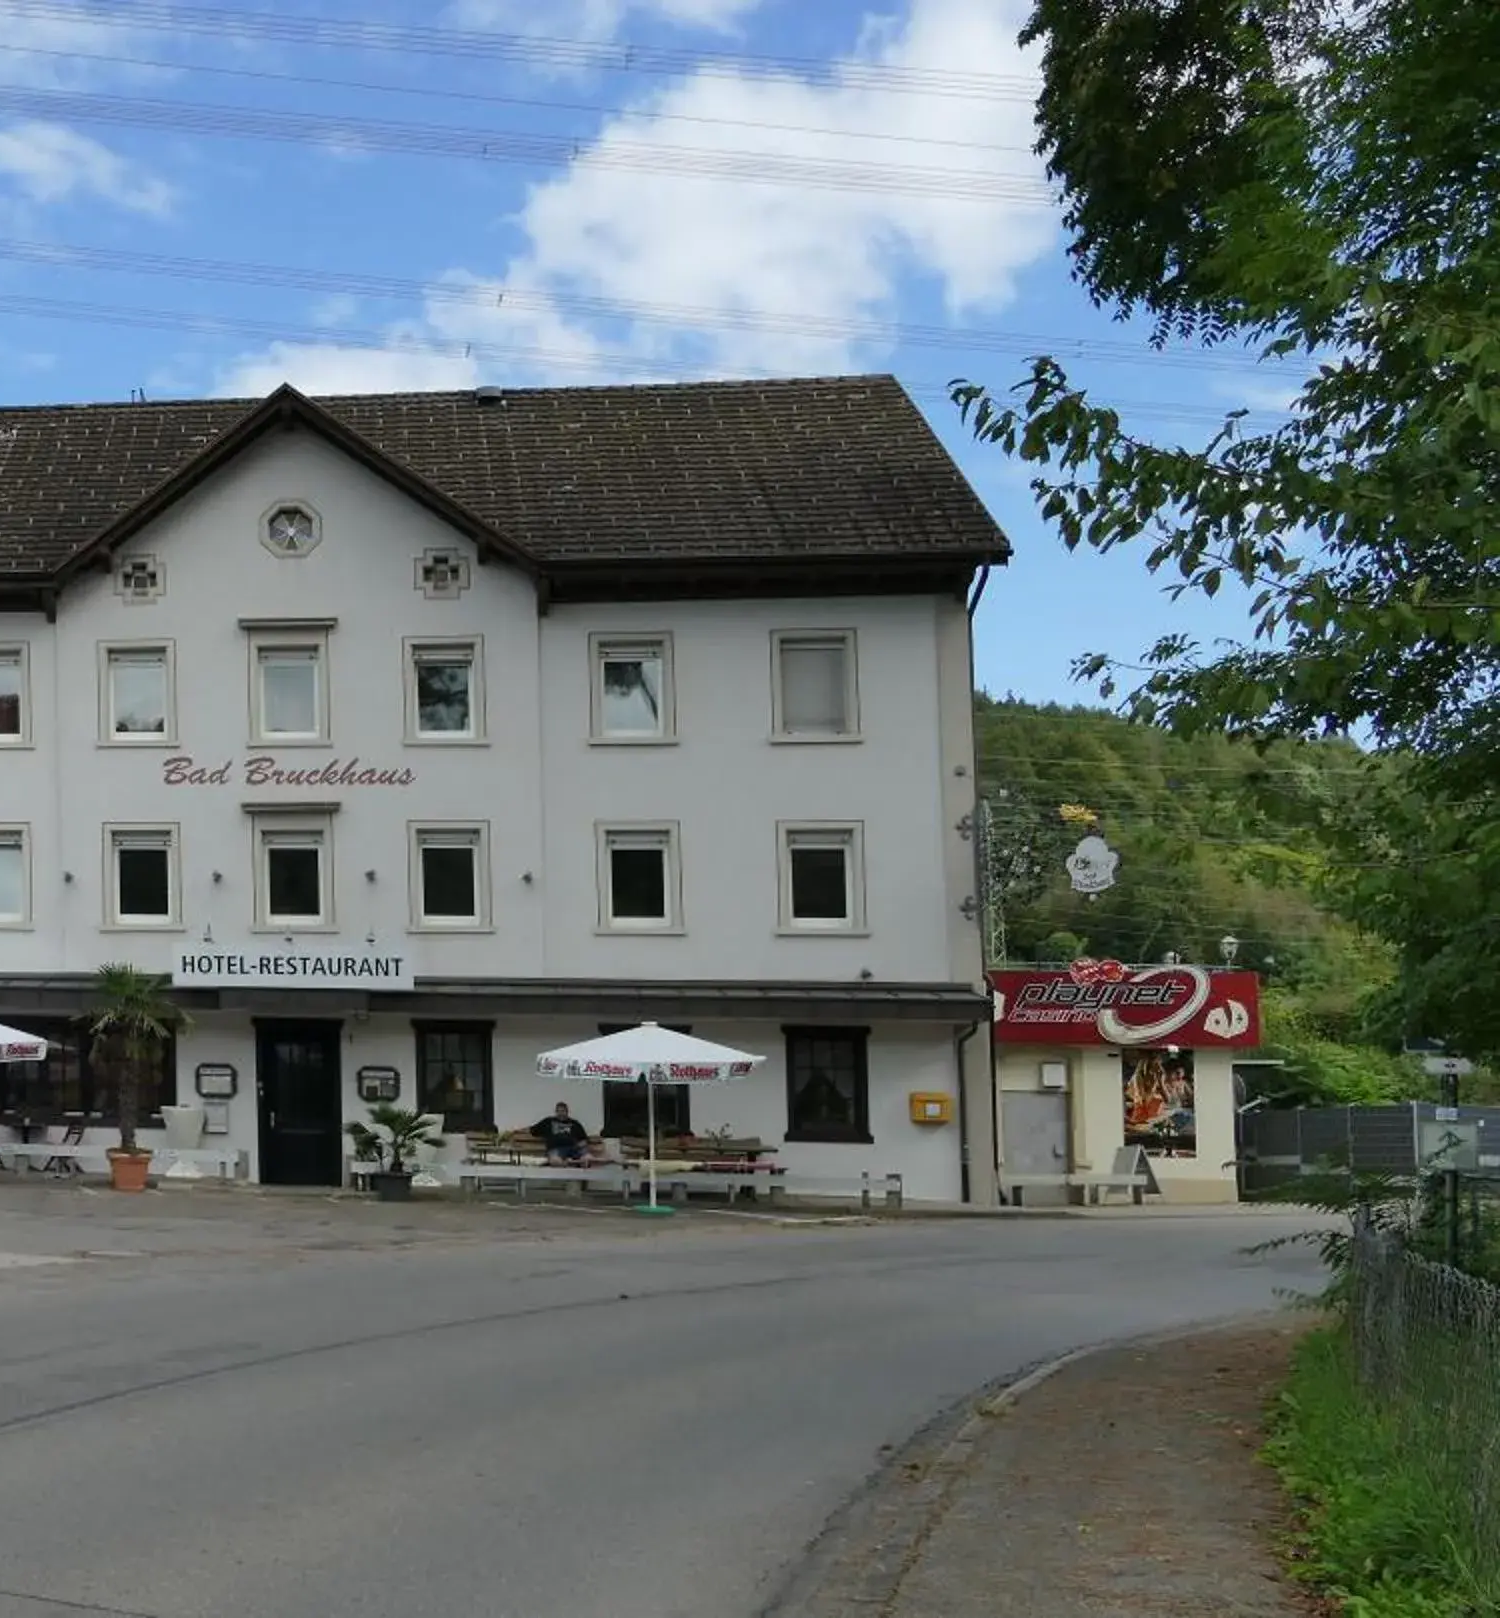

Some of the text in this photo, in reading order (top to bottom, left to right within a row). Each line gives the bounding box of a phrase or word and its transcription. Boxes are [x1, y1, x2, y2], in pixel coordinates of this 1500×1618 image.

[163, 757, 417, 786] Bad Bruckhaus
[181, 954, 404, 977] HOTEL-RESTAURANT
[1014, 978, 1186, 1010] playnet
